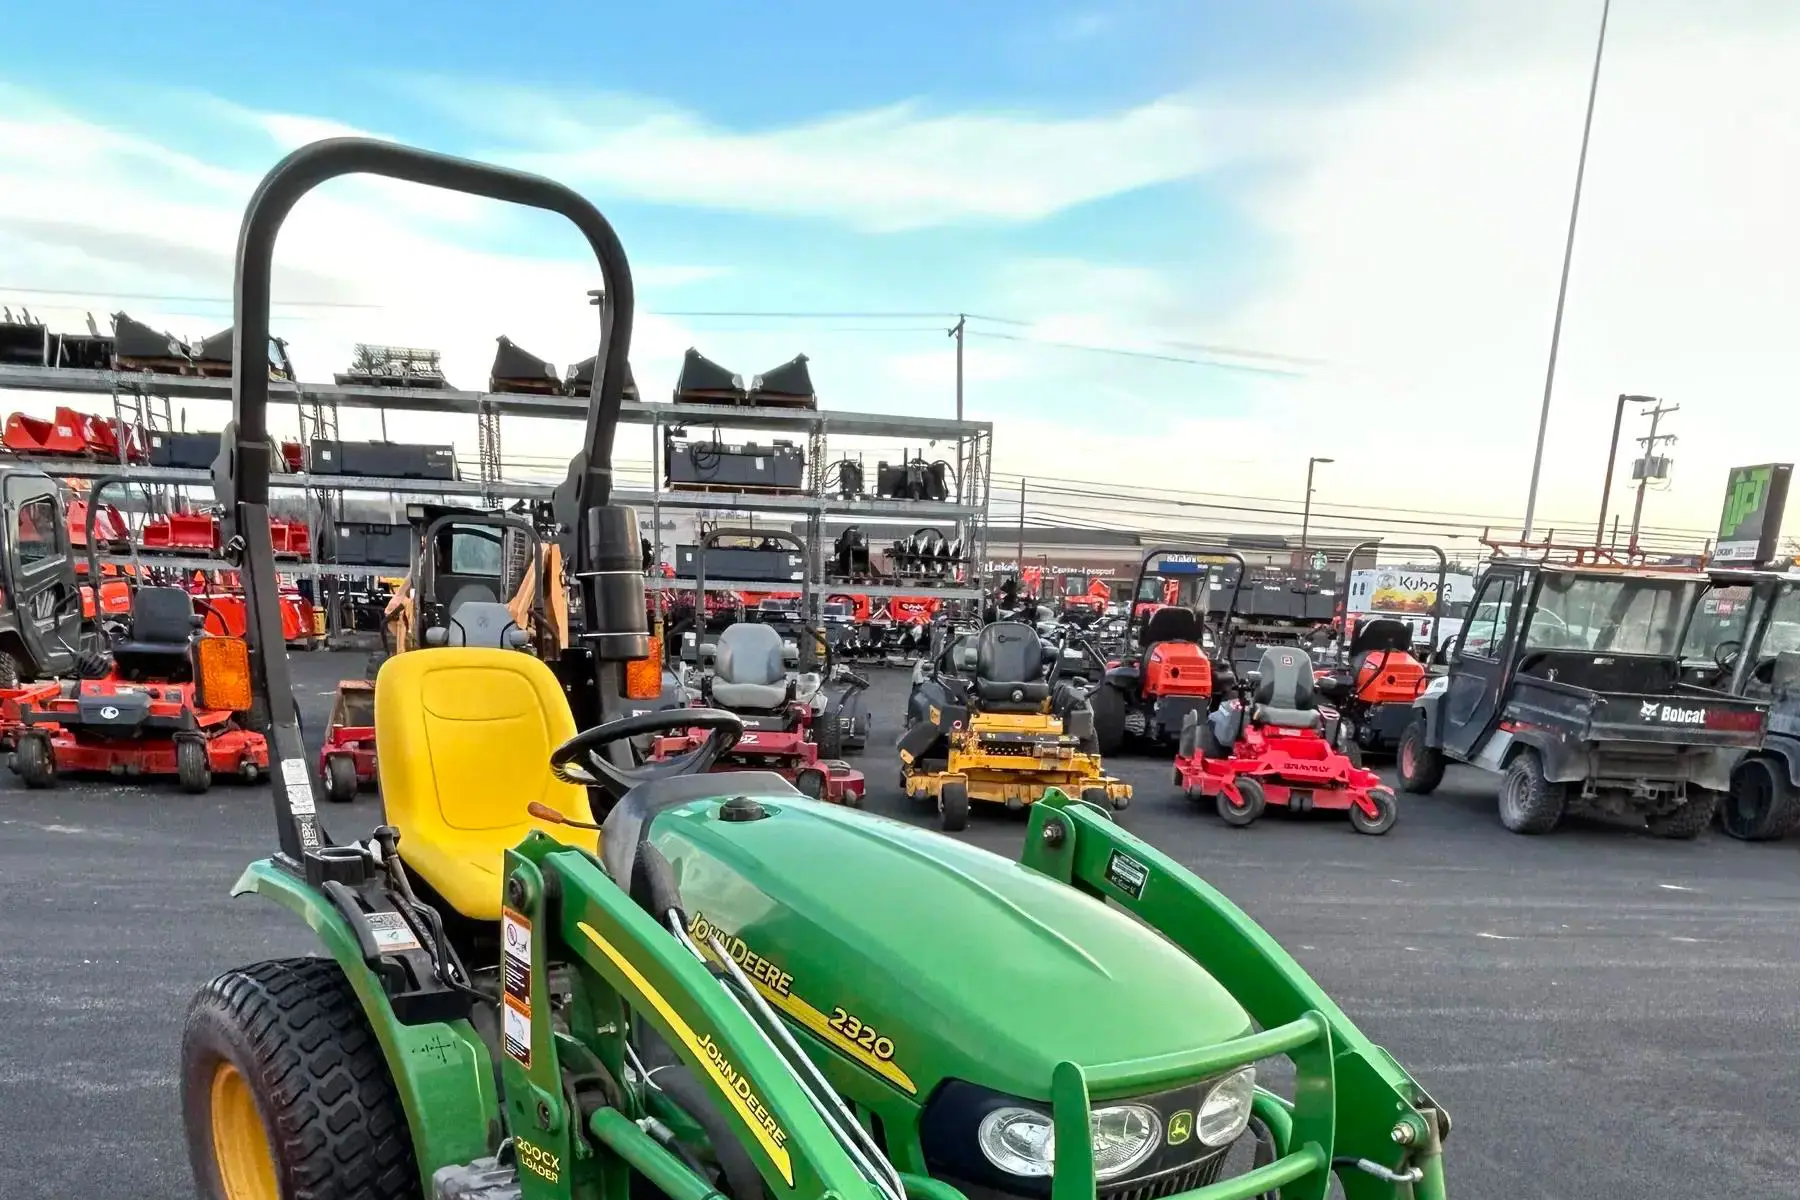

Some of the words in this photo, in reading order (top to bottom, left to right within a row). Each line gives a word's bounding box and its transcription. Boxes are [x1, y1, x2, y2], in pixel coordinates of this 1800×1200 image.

[1399, 576, 1453, 593] Kuboa
[1660, 705, 1706, 724] Bobcat
[688, 911, 731, 952] JOHN
[730, 937, 794, 996] DEERE
[828, 1007, 895, 1060] 2320
[697, 1033, 736, 1086] JOHN
[734, 1080, 787, 1150] DEERE
[517, 1135, 561, 1171] 200CX
[521, 1154, 559, 1184] LOADER
